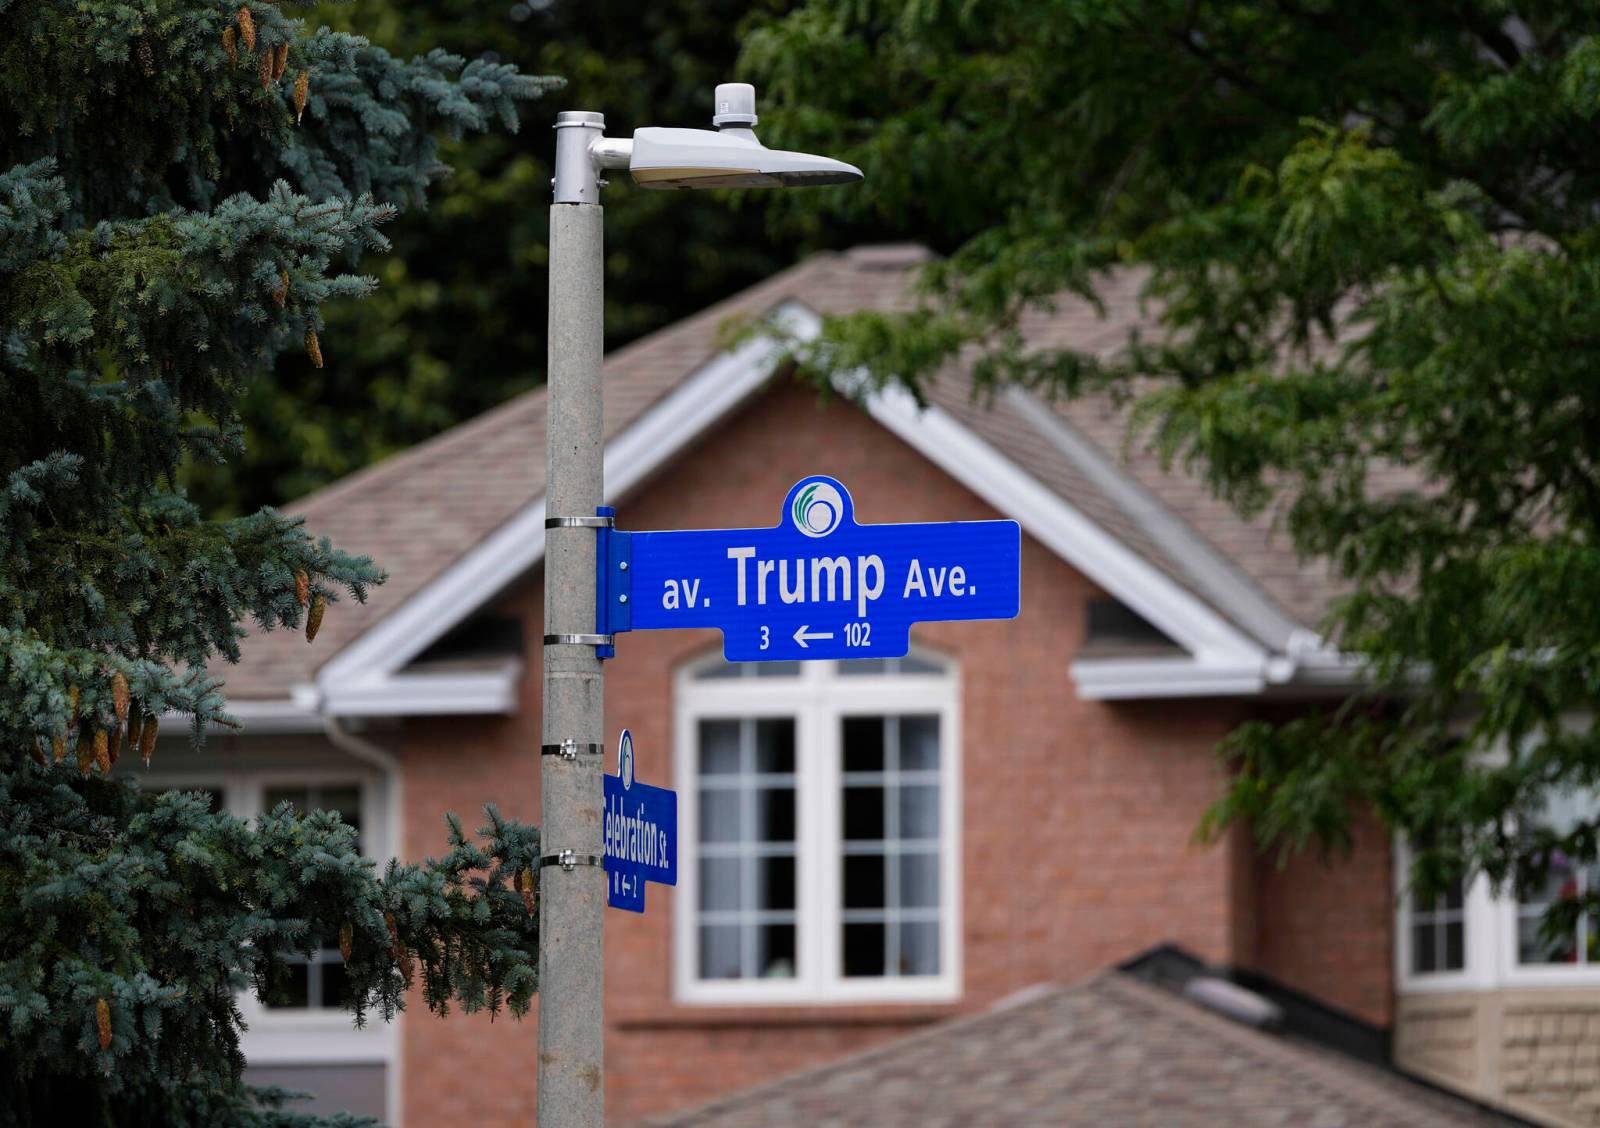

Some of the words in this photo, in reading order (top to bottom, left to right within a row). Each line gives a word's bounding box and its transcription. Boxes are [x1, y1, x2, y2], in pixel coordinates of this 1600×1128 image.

[662, 578, 710, 610] av.
[727, 546, 885, 618] Trump
[903, 559, 976, 598] Ave.
[759, 625, 770, 650] 3
[843, 622, 871, 647] 102
